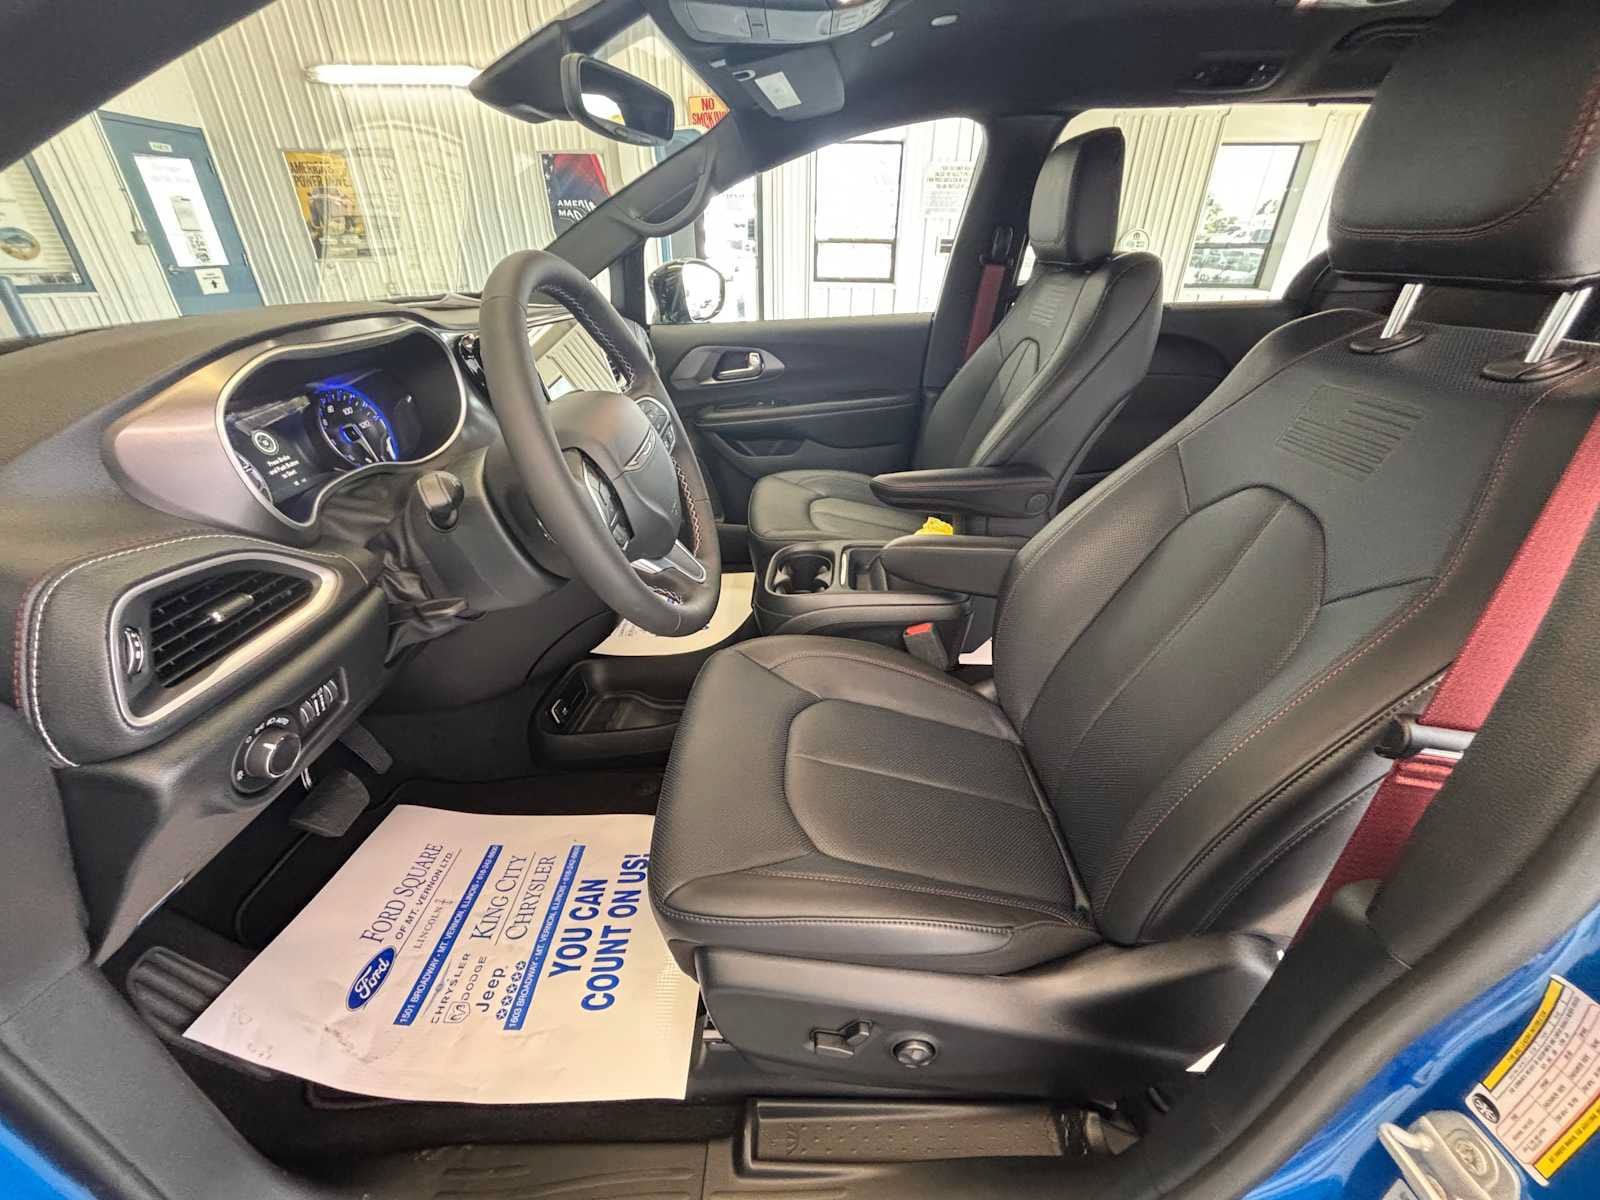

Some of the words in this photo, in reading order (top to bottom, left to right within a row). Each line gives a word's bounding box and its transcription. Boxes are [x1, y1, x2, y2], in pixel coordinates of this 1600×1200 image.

[692, 111, 727, 129] SMOKIN
[701, 98, 715, 110] NO
[616, 854, 650, 884] US!
[395, 927, 408, 940] OF
[405, 911, 418, 927] MT.
[418, 870, 443, 905] VERNON
[469, 896, 509, 941] KING
[495, 855, 528, 895] CITY
[505, 855, 557, 941] CHRYSLER
[569, 879, 609, 921] CAN
[607, 890, 642, 918] ON
[413, 907, 443, 949] LINCOLN
[400, 1003, 416, 1024] 1501
[411, 957, 440, 1003] BROADWAY
[461, 884, 476, 909] ILLINOIS
[547, 927, 593, 977] YOU
[580, 925, 632, 1011] COUNT
[355, 958, 390, 999] Ford
[431, 952, 471, 1025] CHRYSLER
[462, 955, 488, 1002] DODGE
[475, 967, 506, 1013] Jeep
[516, 961, 539, 1008] BROADWAY
